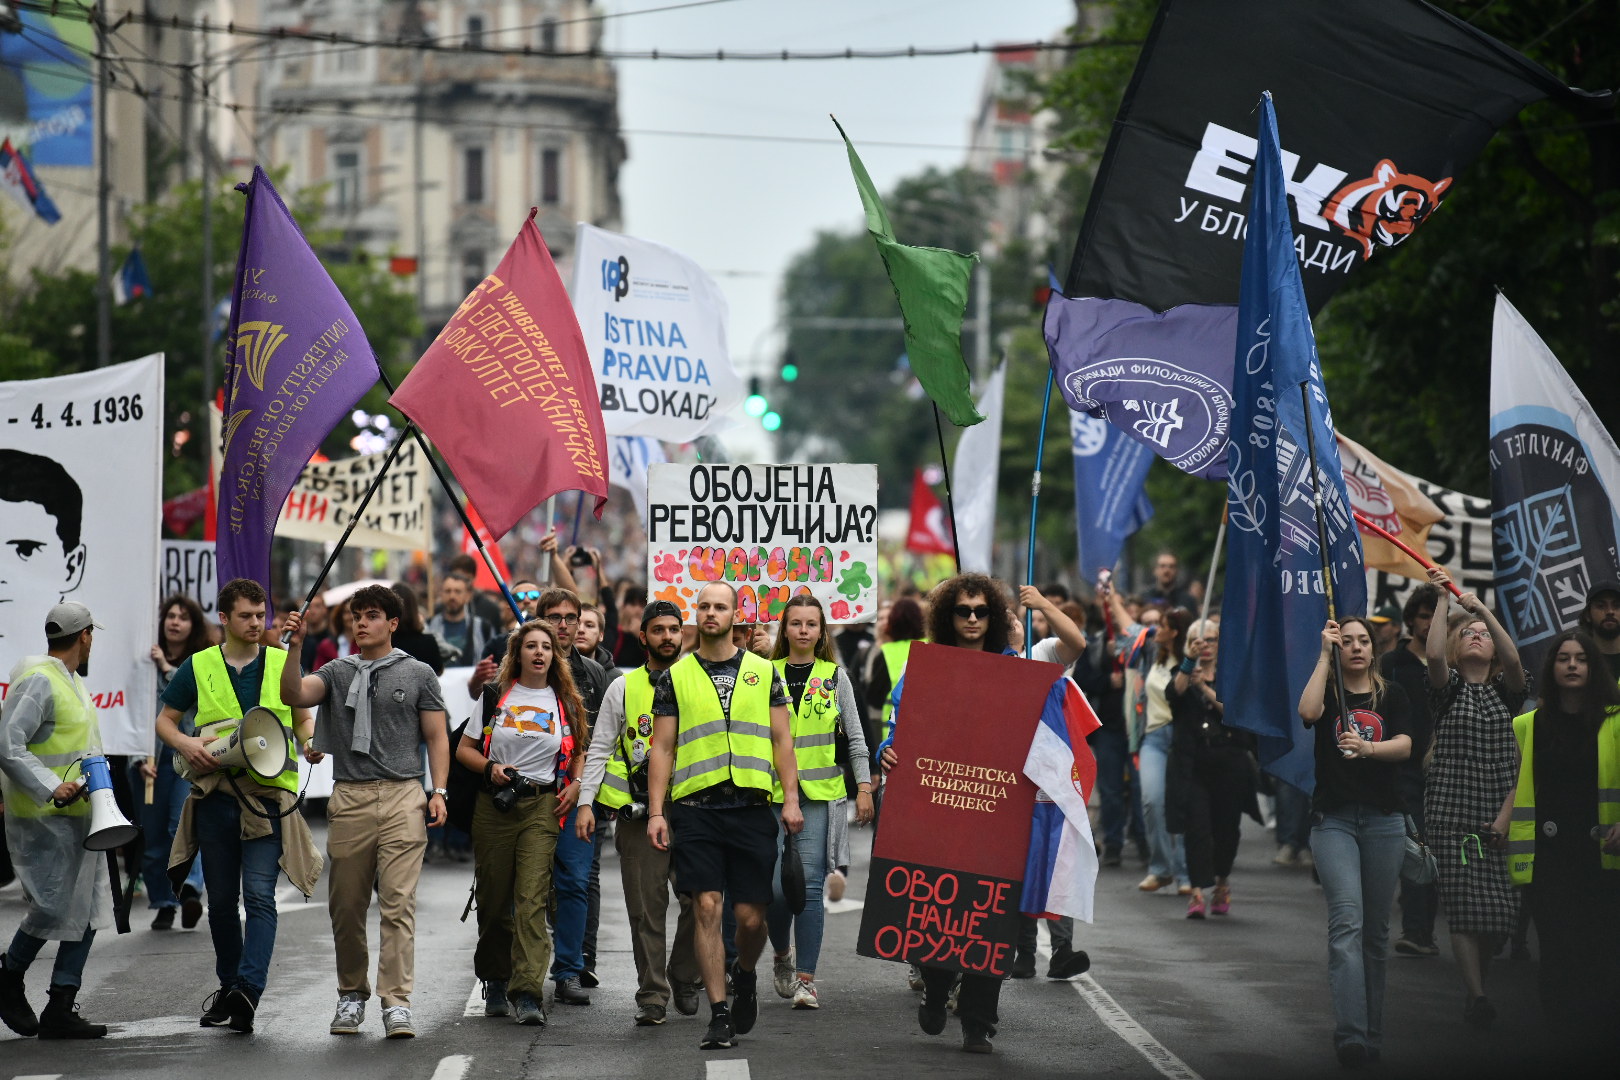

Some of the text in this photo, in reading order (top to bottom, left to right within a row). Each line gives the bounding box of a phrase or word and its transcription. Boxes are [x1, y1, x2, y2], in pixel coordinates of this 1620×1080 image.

[1174, 196, 1357, 274] У БЛАДИ
[604, 312, 688, 349] ISTINA
[444, 326, 529, 408] ФАКУЛТЕТ
[497, 290, 605, 482] УНИВЕРЗИТЕТ У БЕОГРАДУ
[602, 348, 711, 387] PRAVDA
[1131, 363, 1212, 390] ФИЛОЛОШКИ
[468, 303, 594, 478] ЕЛЕКТРОТЕХНИЧКИ
[31, 402, 52, 429] 4.
[60, 401, 82, 427] 4.
[92, 393, 144, 425] 1936
[689, 464, 836, 503] ОБОЈЕНА
[650, 504, 877, 544] РЕВОЛУЦИЈА?
[688, 545, 834, 583] ШАРЕНА
[736, 584, 812, 624] АЖ
[89, 690, 124, 709] ИЈА
[915, 757, 1018, 785] СТУДЕНТСКА
[919, 773, 1008, 799] КЊИЖИЦА
[930, 791, 997, 813] ИНДЕКС
[885, 866, 1011, 914] ОВО ЈЕ
[906, 902, 988, 940] НАШЕ
[874, 925, 1010, 976] ОРУЖЈЕ
